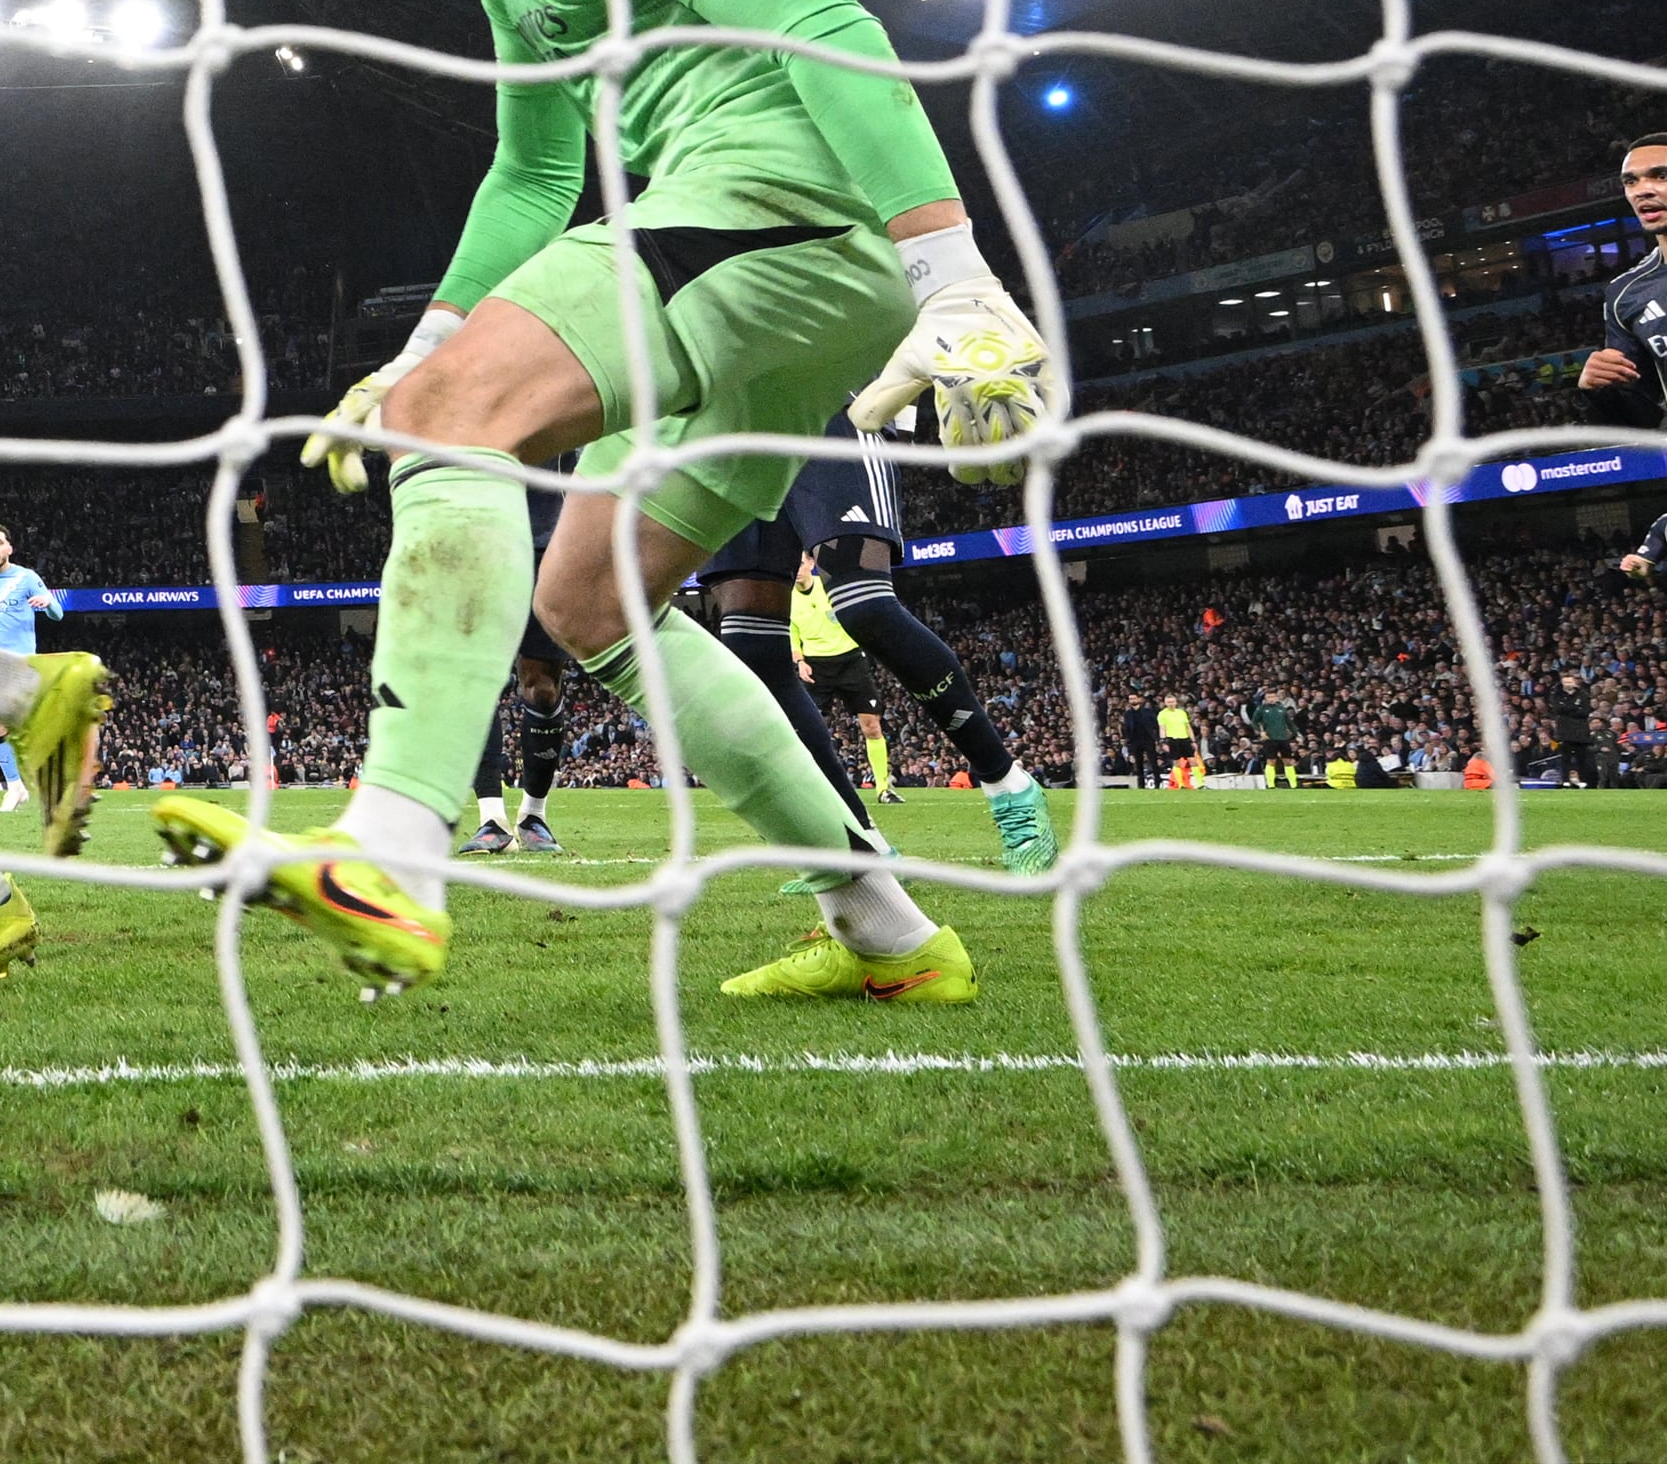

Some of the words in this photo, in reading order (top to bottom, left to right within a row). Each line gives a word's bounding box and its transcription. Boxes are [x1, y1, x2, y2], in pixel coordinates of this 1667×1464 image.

[1540, 457, 1621, 480] mastercard
[1305, 498, 1334, 516] JUST
[1336, 494, 1359, 510] EAT
[1075, 523, 1138, 540] CHAMPIONS
[1139, 515, 1182, 532] LEAGUE
[913, 542, 955, 560] bet365
[102, 592, 144, 604] QATAR
[147, 591, 199, 602] AIRWAYS
[294, 589, 323, 600] UEFA
[328, 587, 382, 598] CHAMPIO
